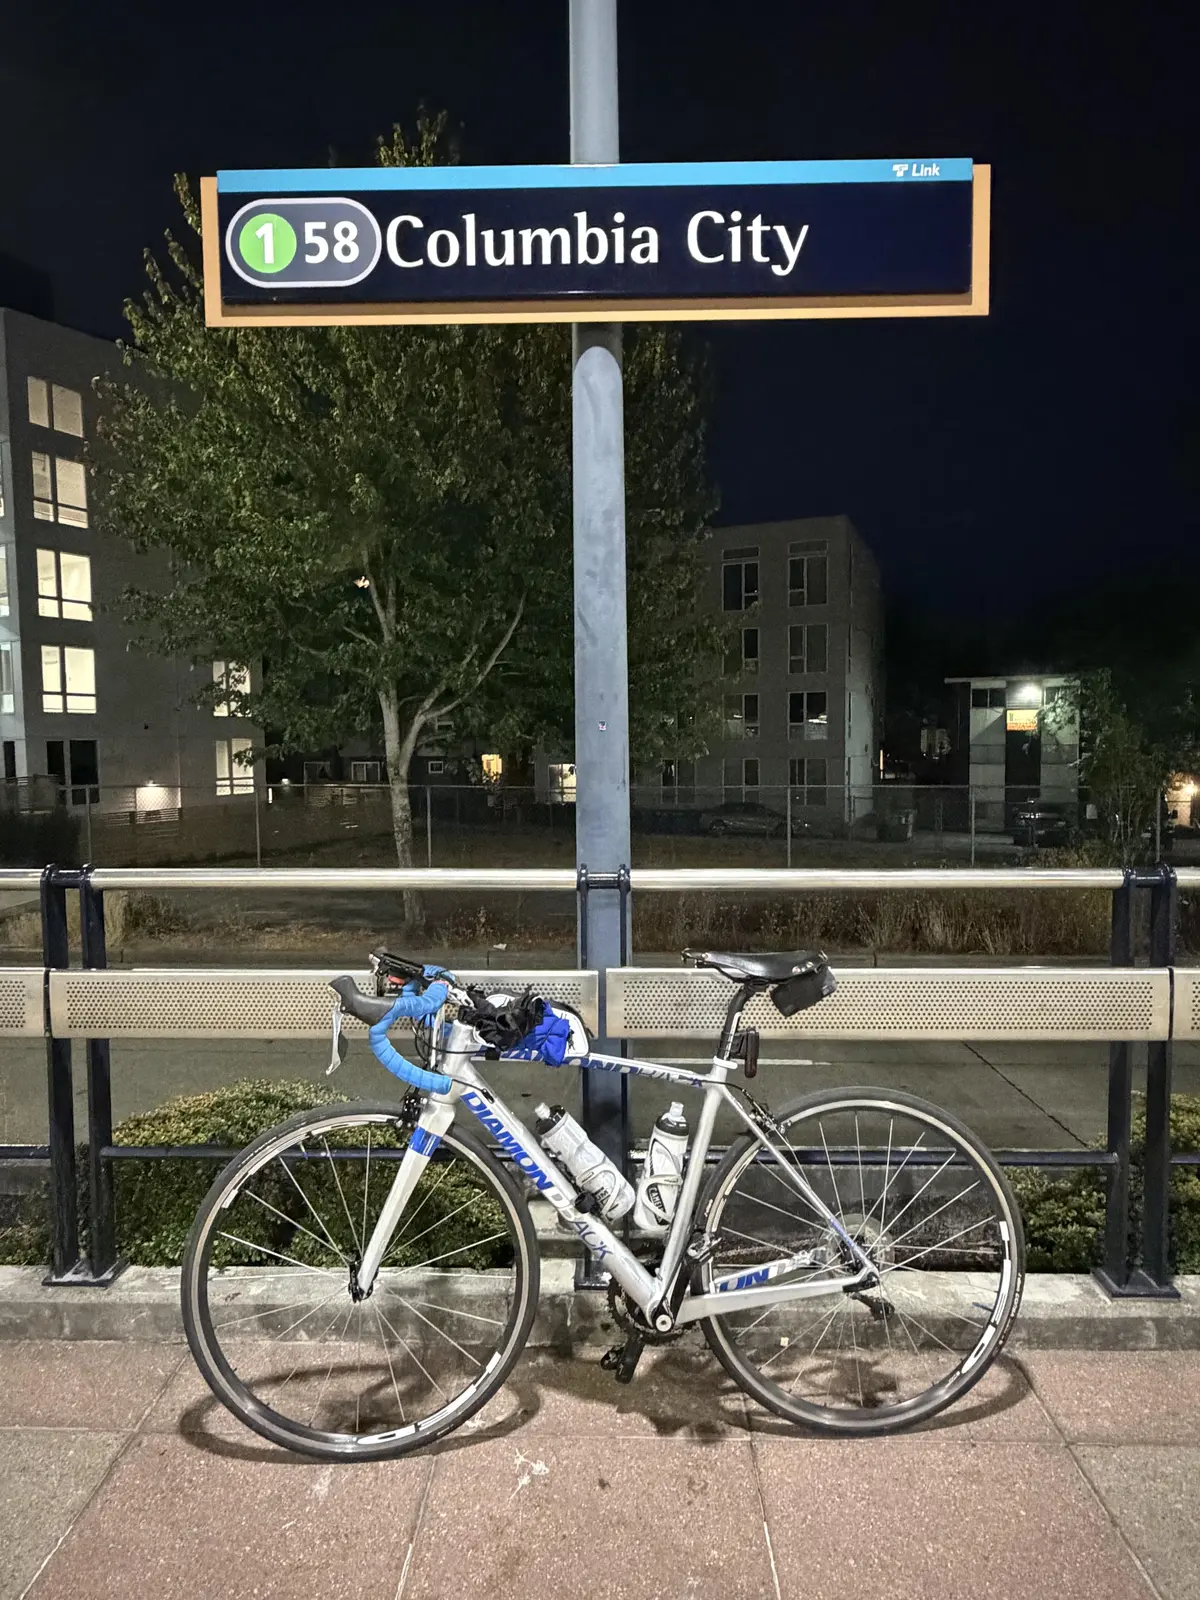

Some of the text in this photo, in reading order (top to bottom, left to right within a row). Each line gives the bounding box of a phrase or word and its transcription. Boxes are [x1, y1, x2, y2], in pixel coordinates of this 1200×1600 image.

[911, 163, 940, 177] Link
[255, 220, 360, 264] 1 58
[386, 210, 809, 277] Columbia City
